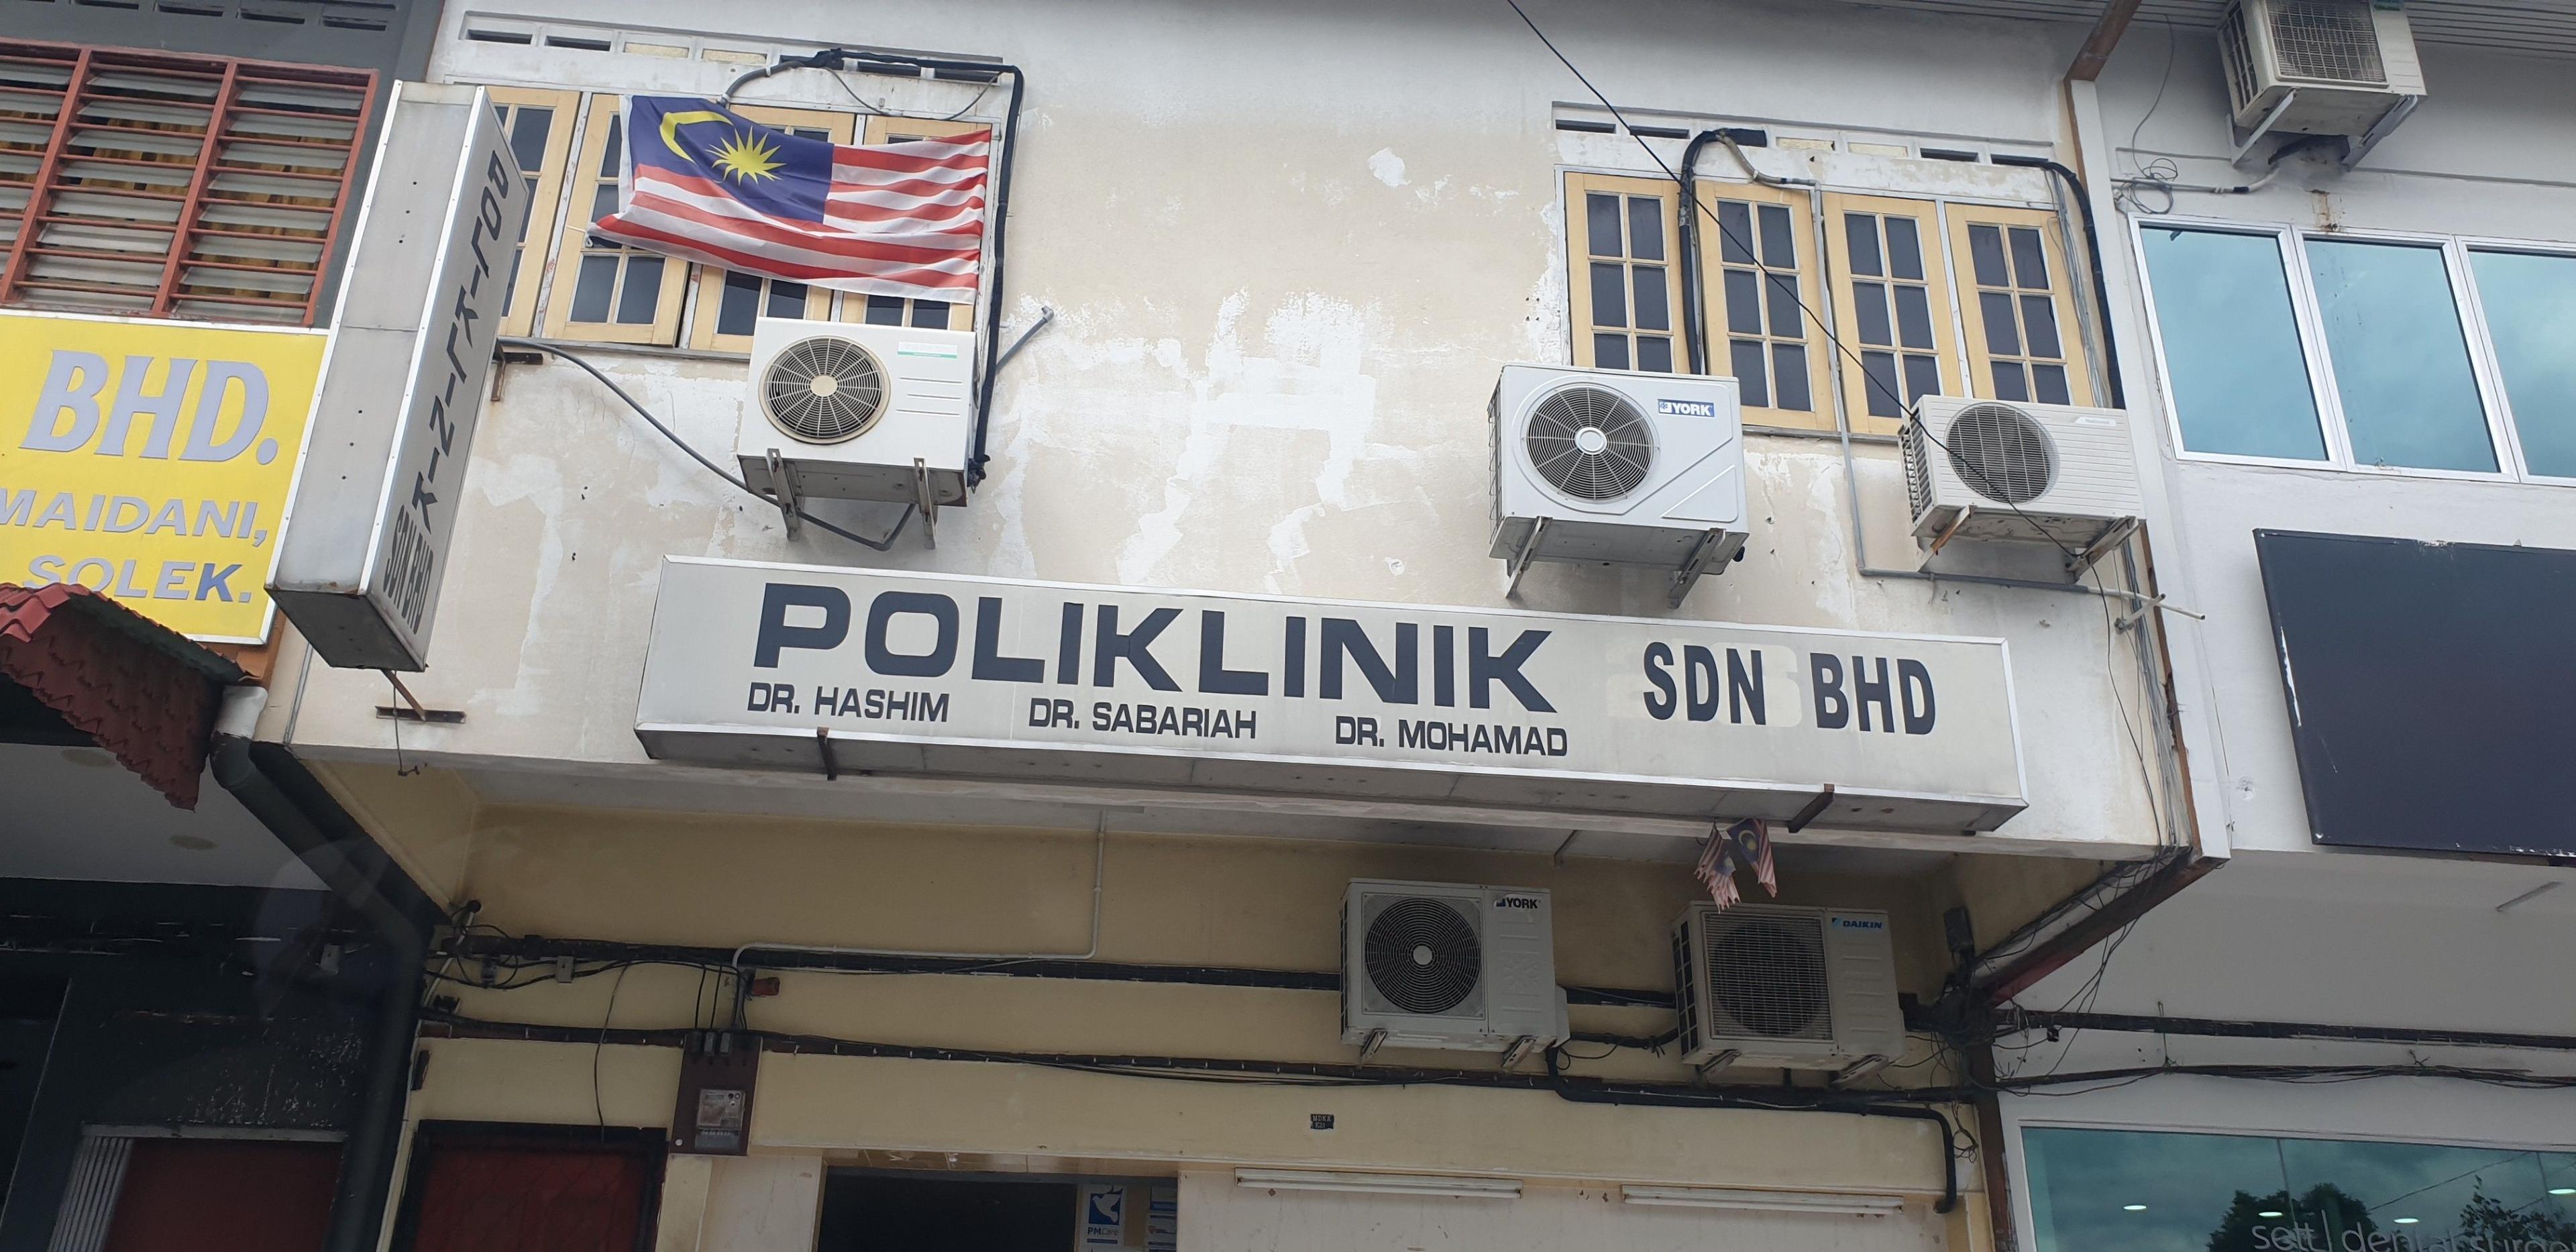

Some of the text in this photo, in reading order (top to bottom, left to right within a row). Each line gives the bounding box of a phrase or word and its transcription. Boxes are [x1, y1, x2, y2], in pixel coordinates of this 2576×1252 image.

[412, 150, 508, 535] POLIKLINIK
[18, 350, 278, 465] BHD.
[1672, 402, 1711, 416] YORK
[23, 555, 252, 603] SOLEK.
[383, 505, 433, 635] SDN BHD
[754, 582, 1558, 713] POLIKLINIK
[747, 682, 949, 723] DR. HASHIM
[1643, 641, 1935, 735] SDN BHD
[1028, 697, 1256, 739] DR. SABARIAH
[1336, 715, 1568, 757] DR. MOHAMAD
[1506, 897, 1538, 909] YORK
[1843, 920, 1882, 929] DAIKIN
